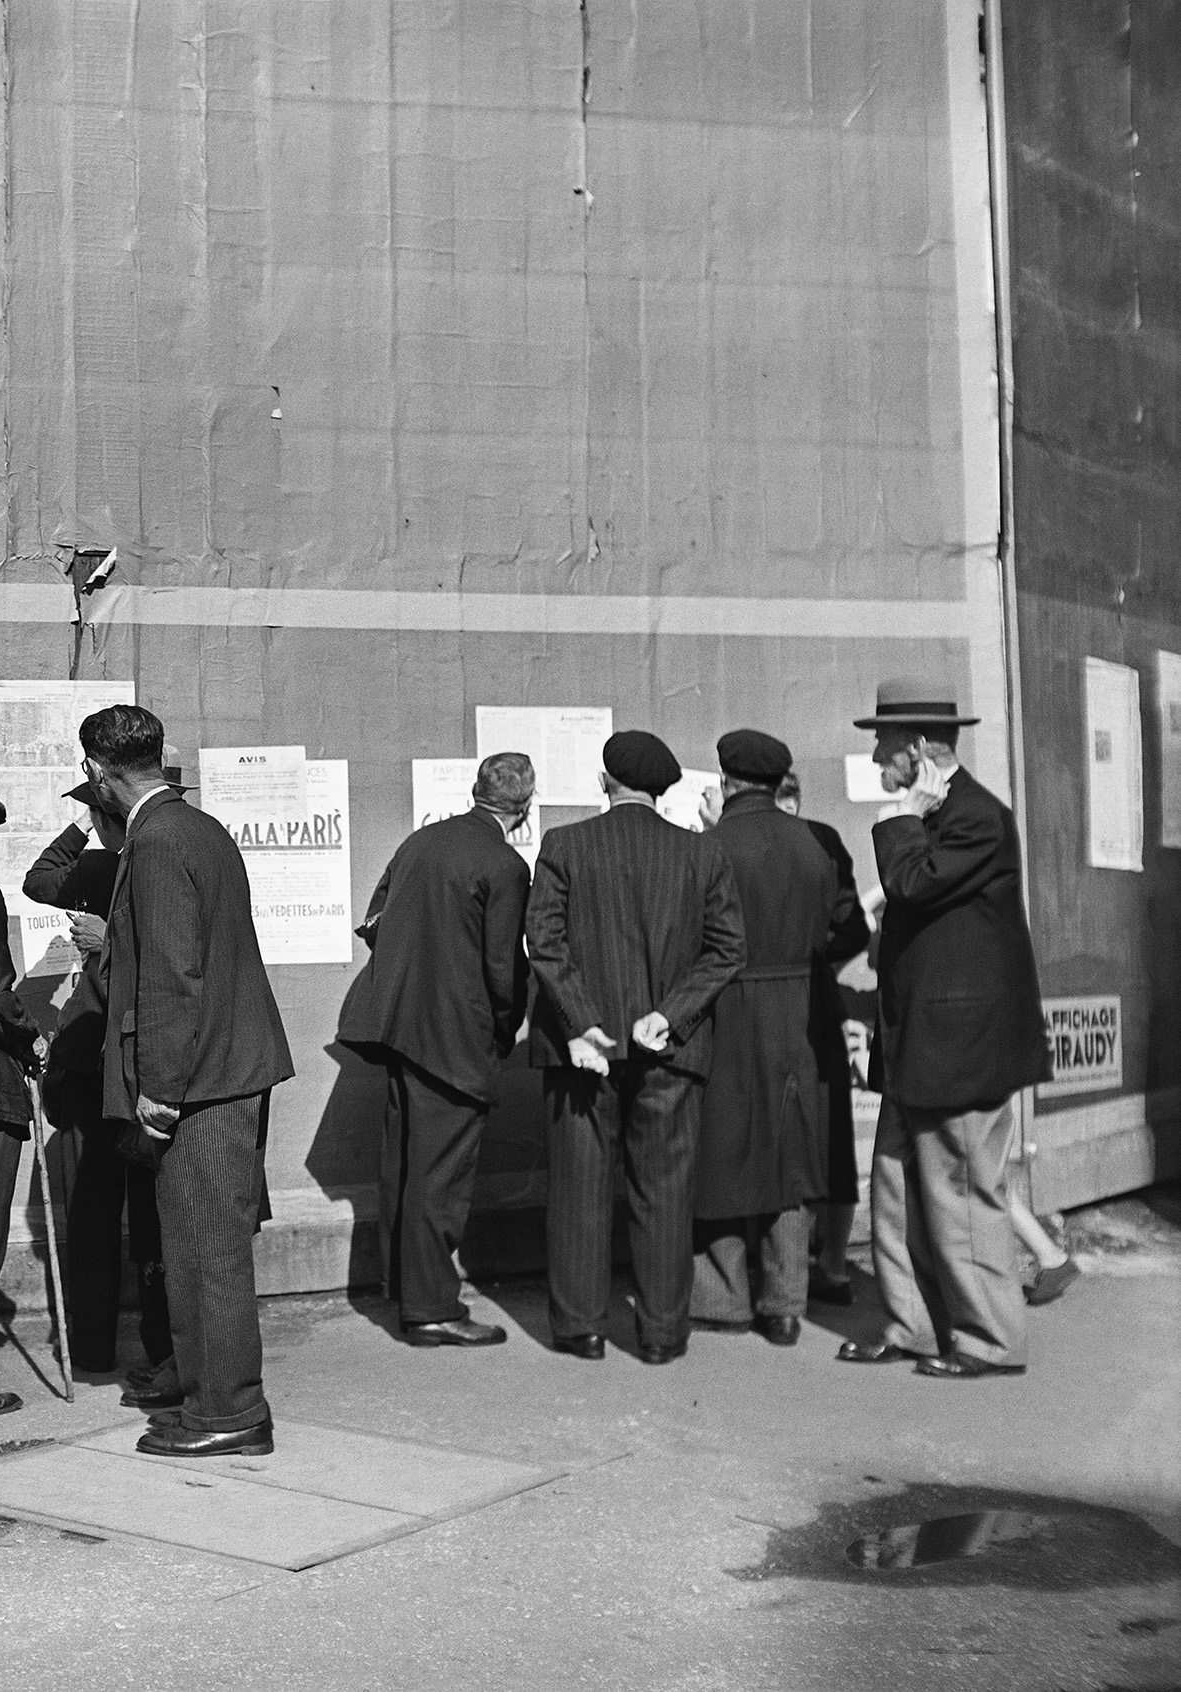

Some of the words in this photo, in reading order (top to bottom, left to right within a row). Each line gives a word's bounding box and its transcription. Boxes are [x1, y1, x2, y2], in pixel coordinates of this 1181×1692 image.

[238, 756, 267, 764] AVIS
[269, 904, 312, 917] VEDETTES
[319, 904, 345, 916] PARIS
[27, 915, 61, 930] TOUTES
